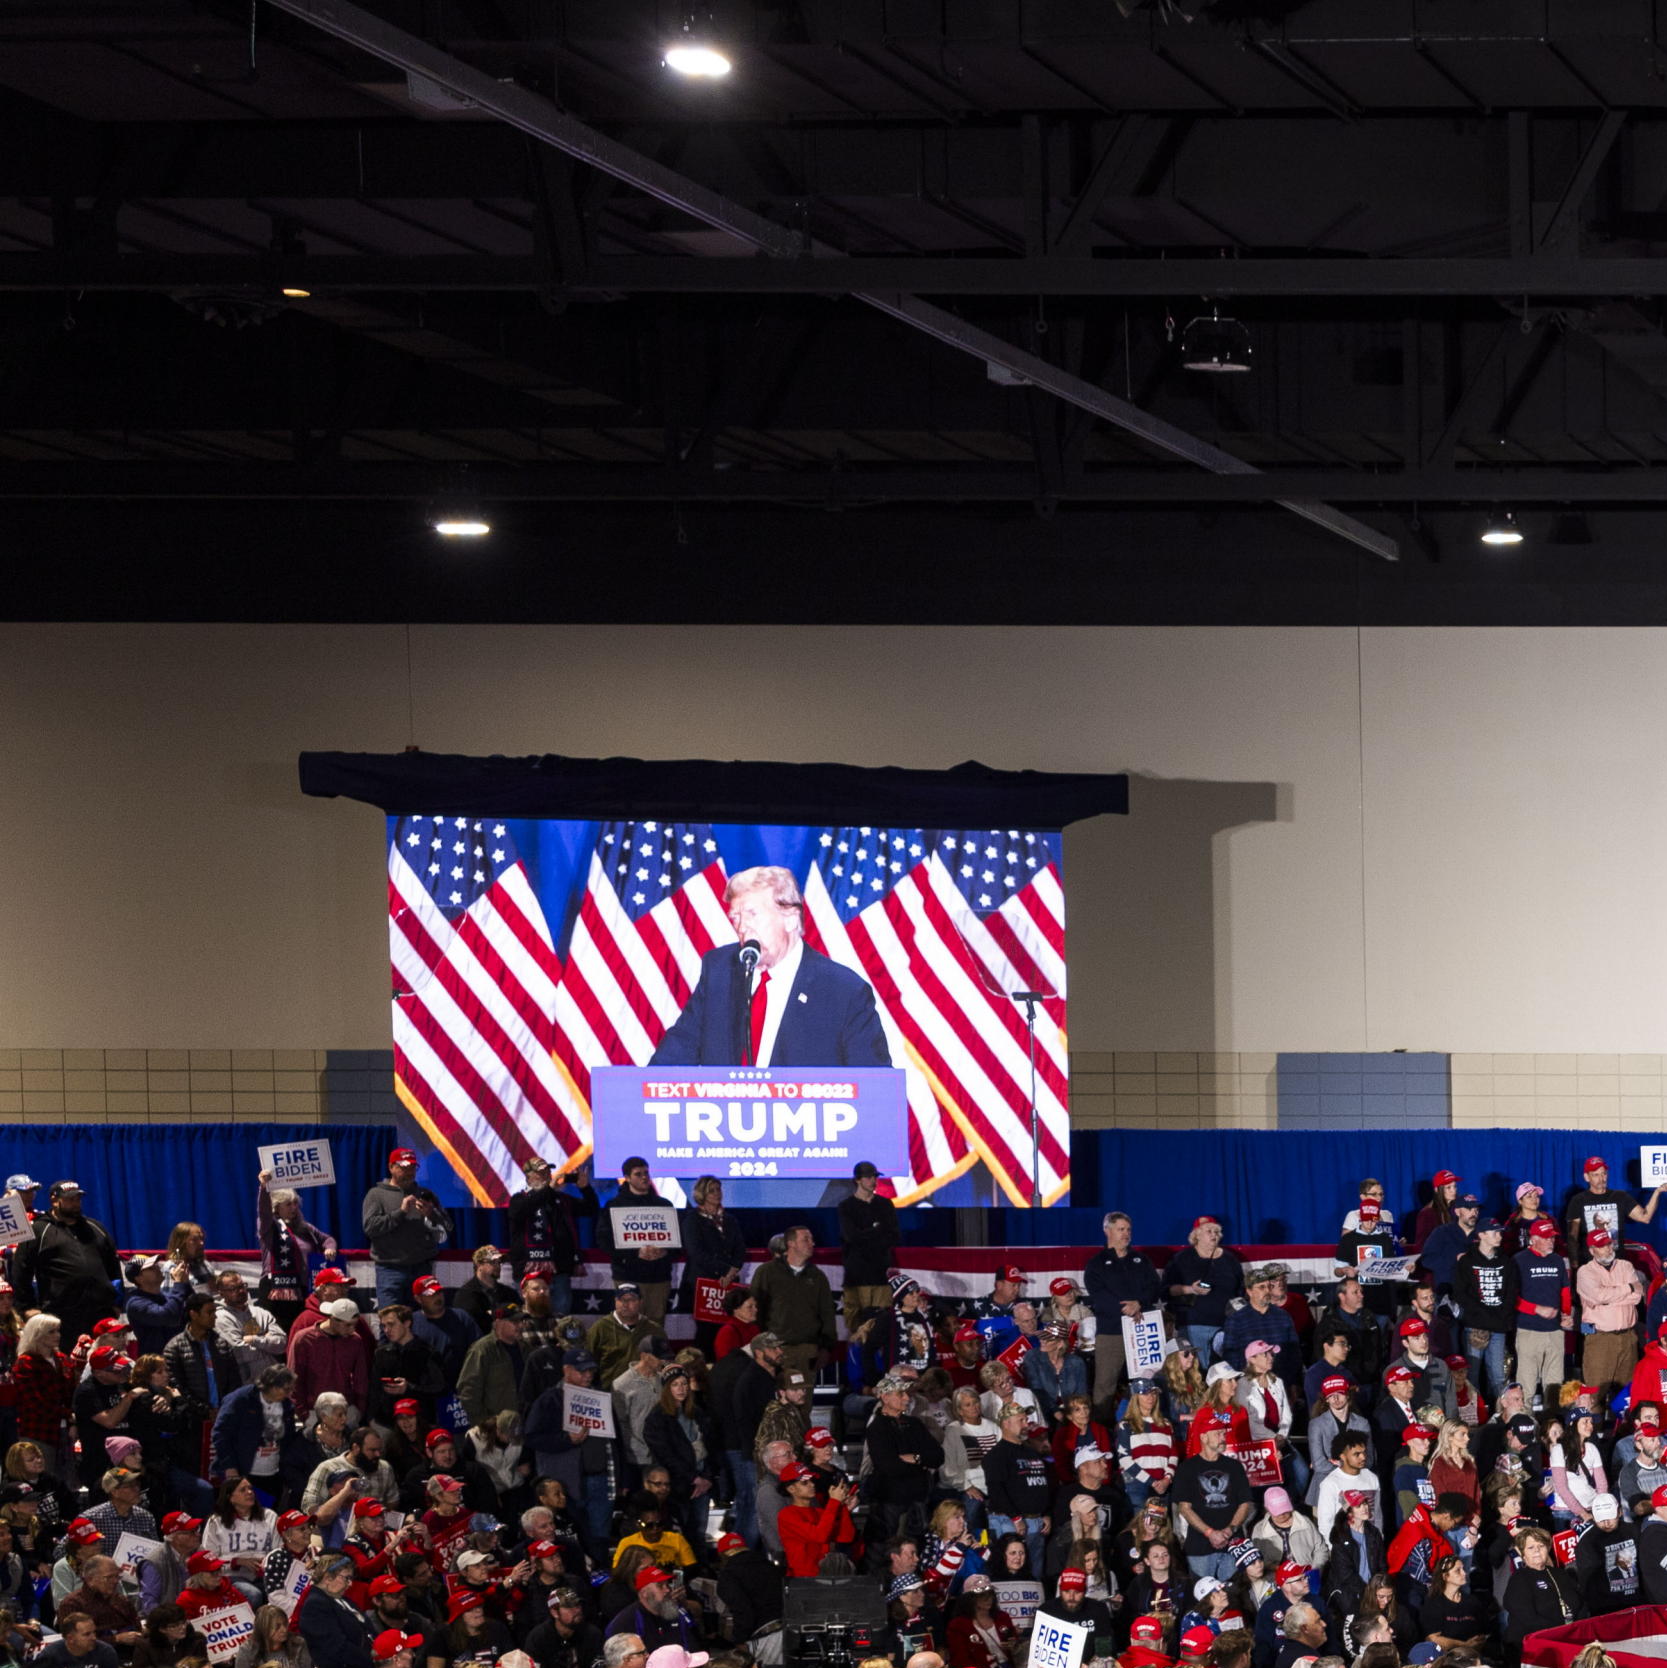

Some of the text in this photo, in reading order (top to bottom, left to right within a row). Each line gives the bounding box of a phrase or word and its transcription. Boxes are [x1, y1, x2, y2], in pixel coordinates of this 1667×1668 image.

[649, 1083, 689, 1098] TEXT
[695, 1083, 770, 1098] VIRGINIA
[776, 1083, 797, 1098] TO
[644, 1102, 858, 1143] TRUMP
[272, 1148, 320, 1167] FIRE
[657, 1147, 848, 1159] MAKE AMERICA GREAT AGAIN!
[275, 1162, 321, 1178] BIDEN
[729, 1161, 777, 1177] 2024
[622, 1222, 667, 1231] YOU'RE
[623, 1232, 671, 1242] FIRED!
[1371, 1260, 1408, 1268] FIRE
[701, 1286, 726, 1300] TRU
[706, 1299, 722, 1310] 20
[1134, 1323, 1149, 1367] BIDEN
[1146, 1322, 1162, 1364] FIRE
[293, 1574, 309, 1595] BIG
[1022, 1590, 1040, 1601] BIG
[202, 1614, 239, 1633] VOTE
[207, 1622, 254, 1643] ONALD
[209, 1633, 253, 1655] TRUM
[1040, 1624, 1073, 1663] FIRE
